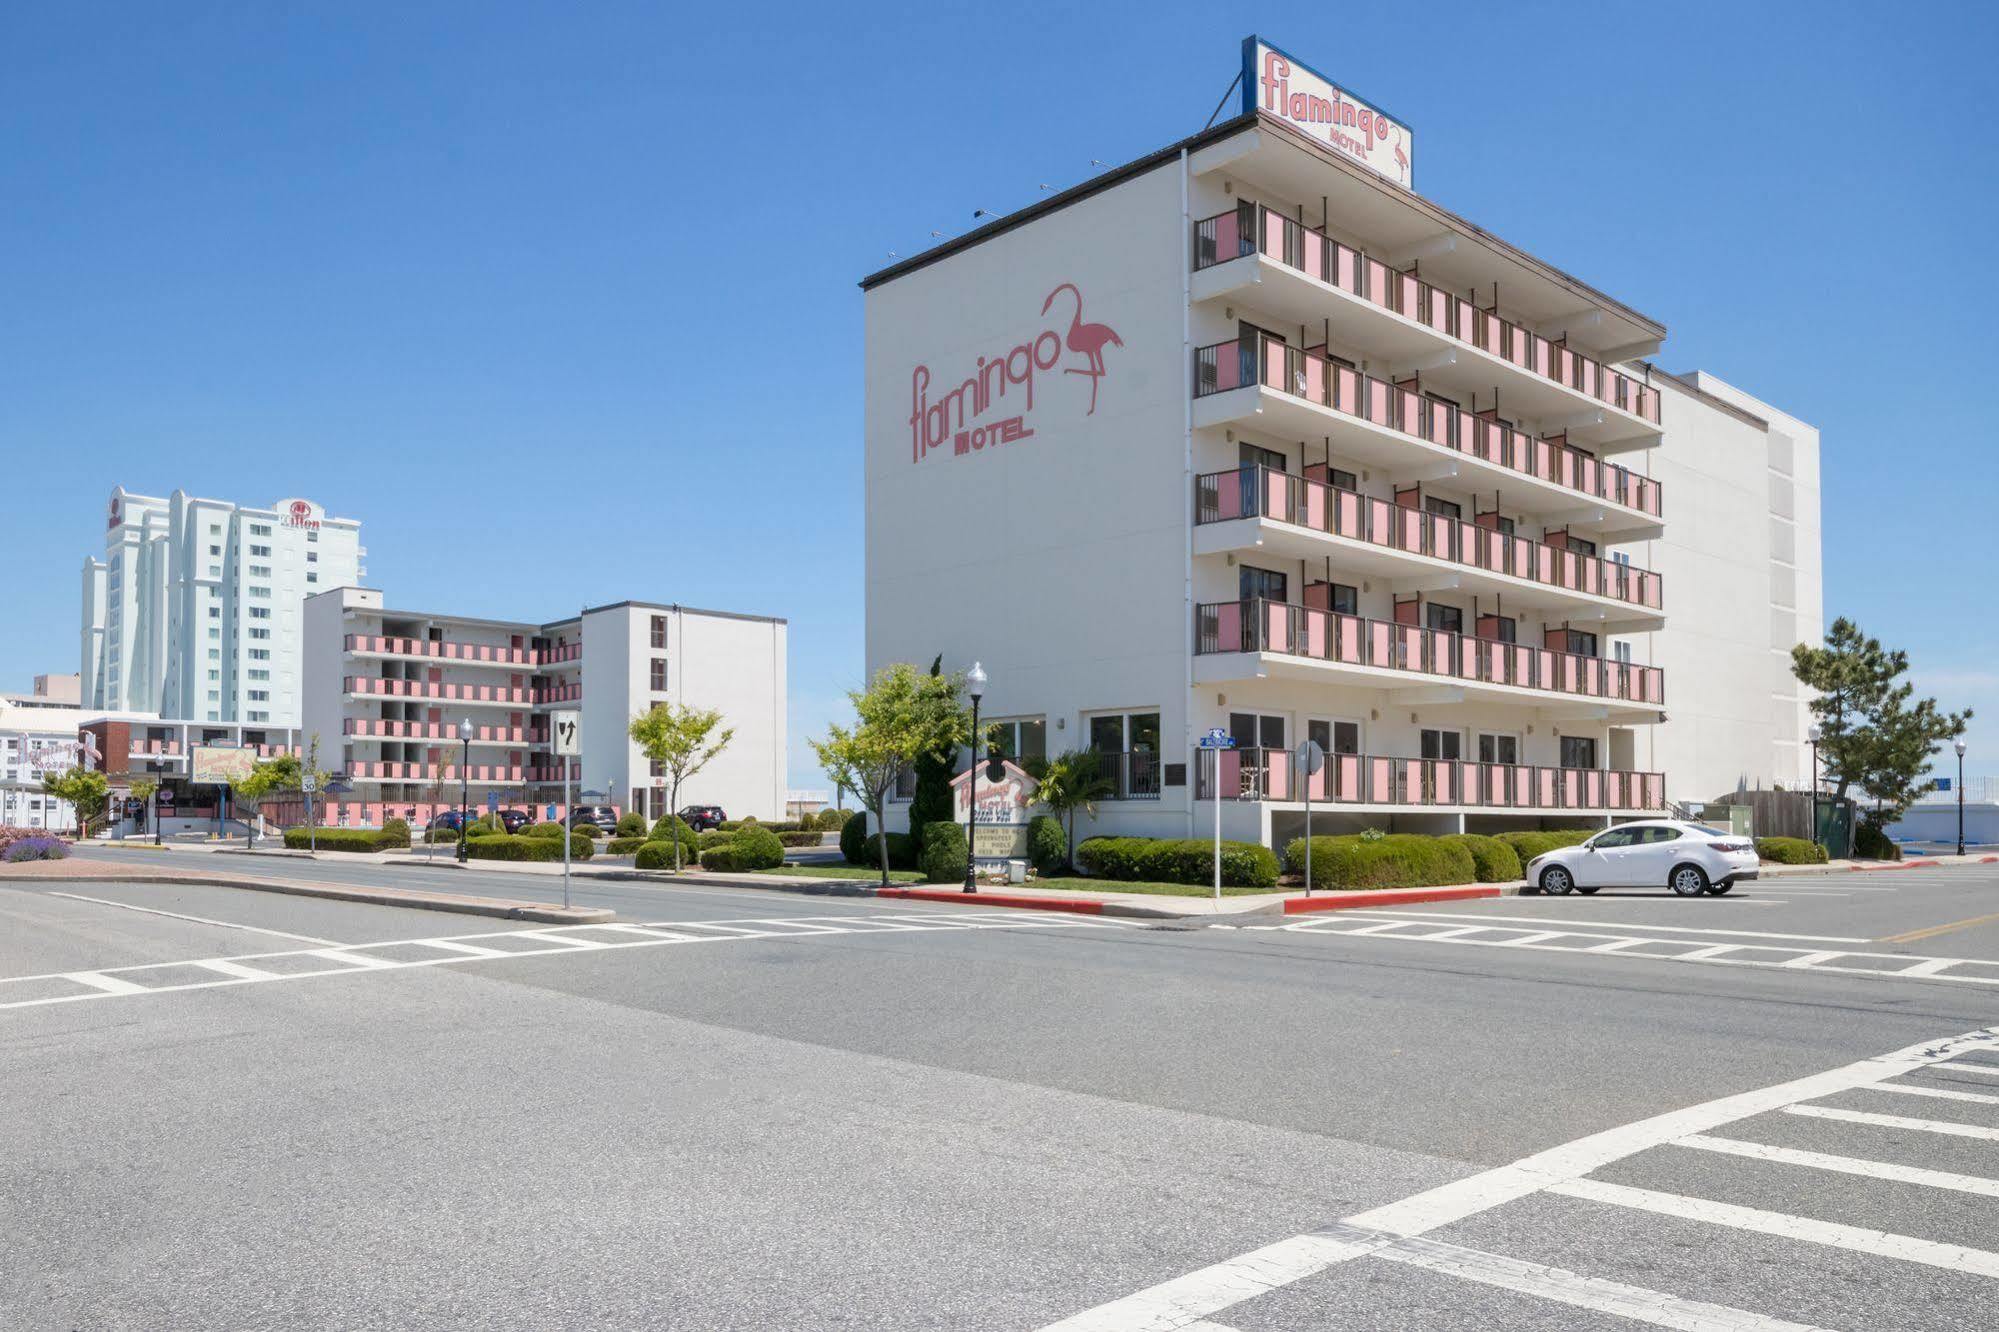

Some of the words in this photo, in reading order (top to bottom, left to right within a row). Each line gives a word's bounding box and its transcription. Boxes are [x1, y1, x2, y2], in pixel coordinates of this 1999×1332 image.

[1330, 127, 1368, 160] MOTEL
[954, 416, 1034, 456] MOTEL
[304, 783, 315, 791] 30
